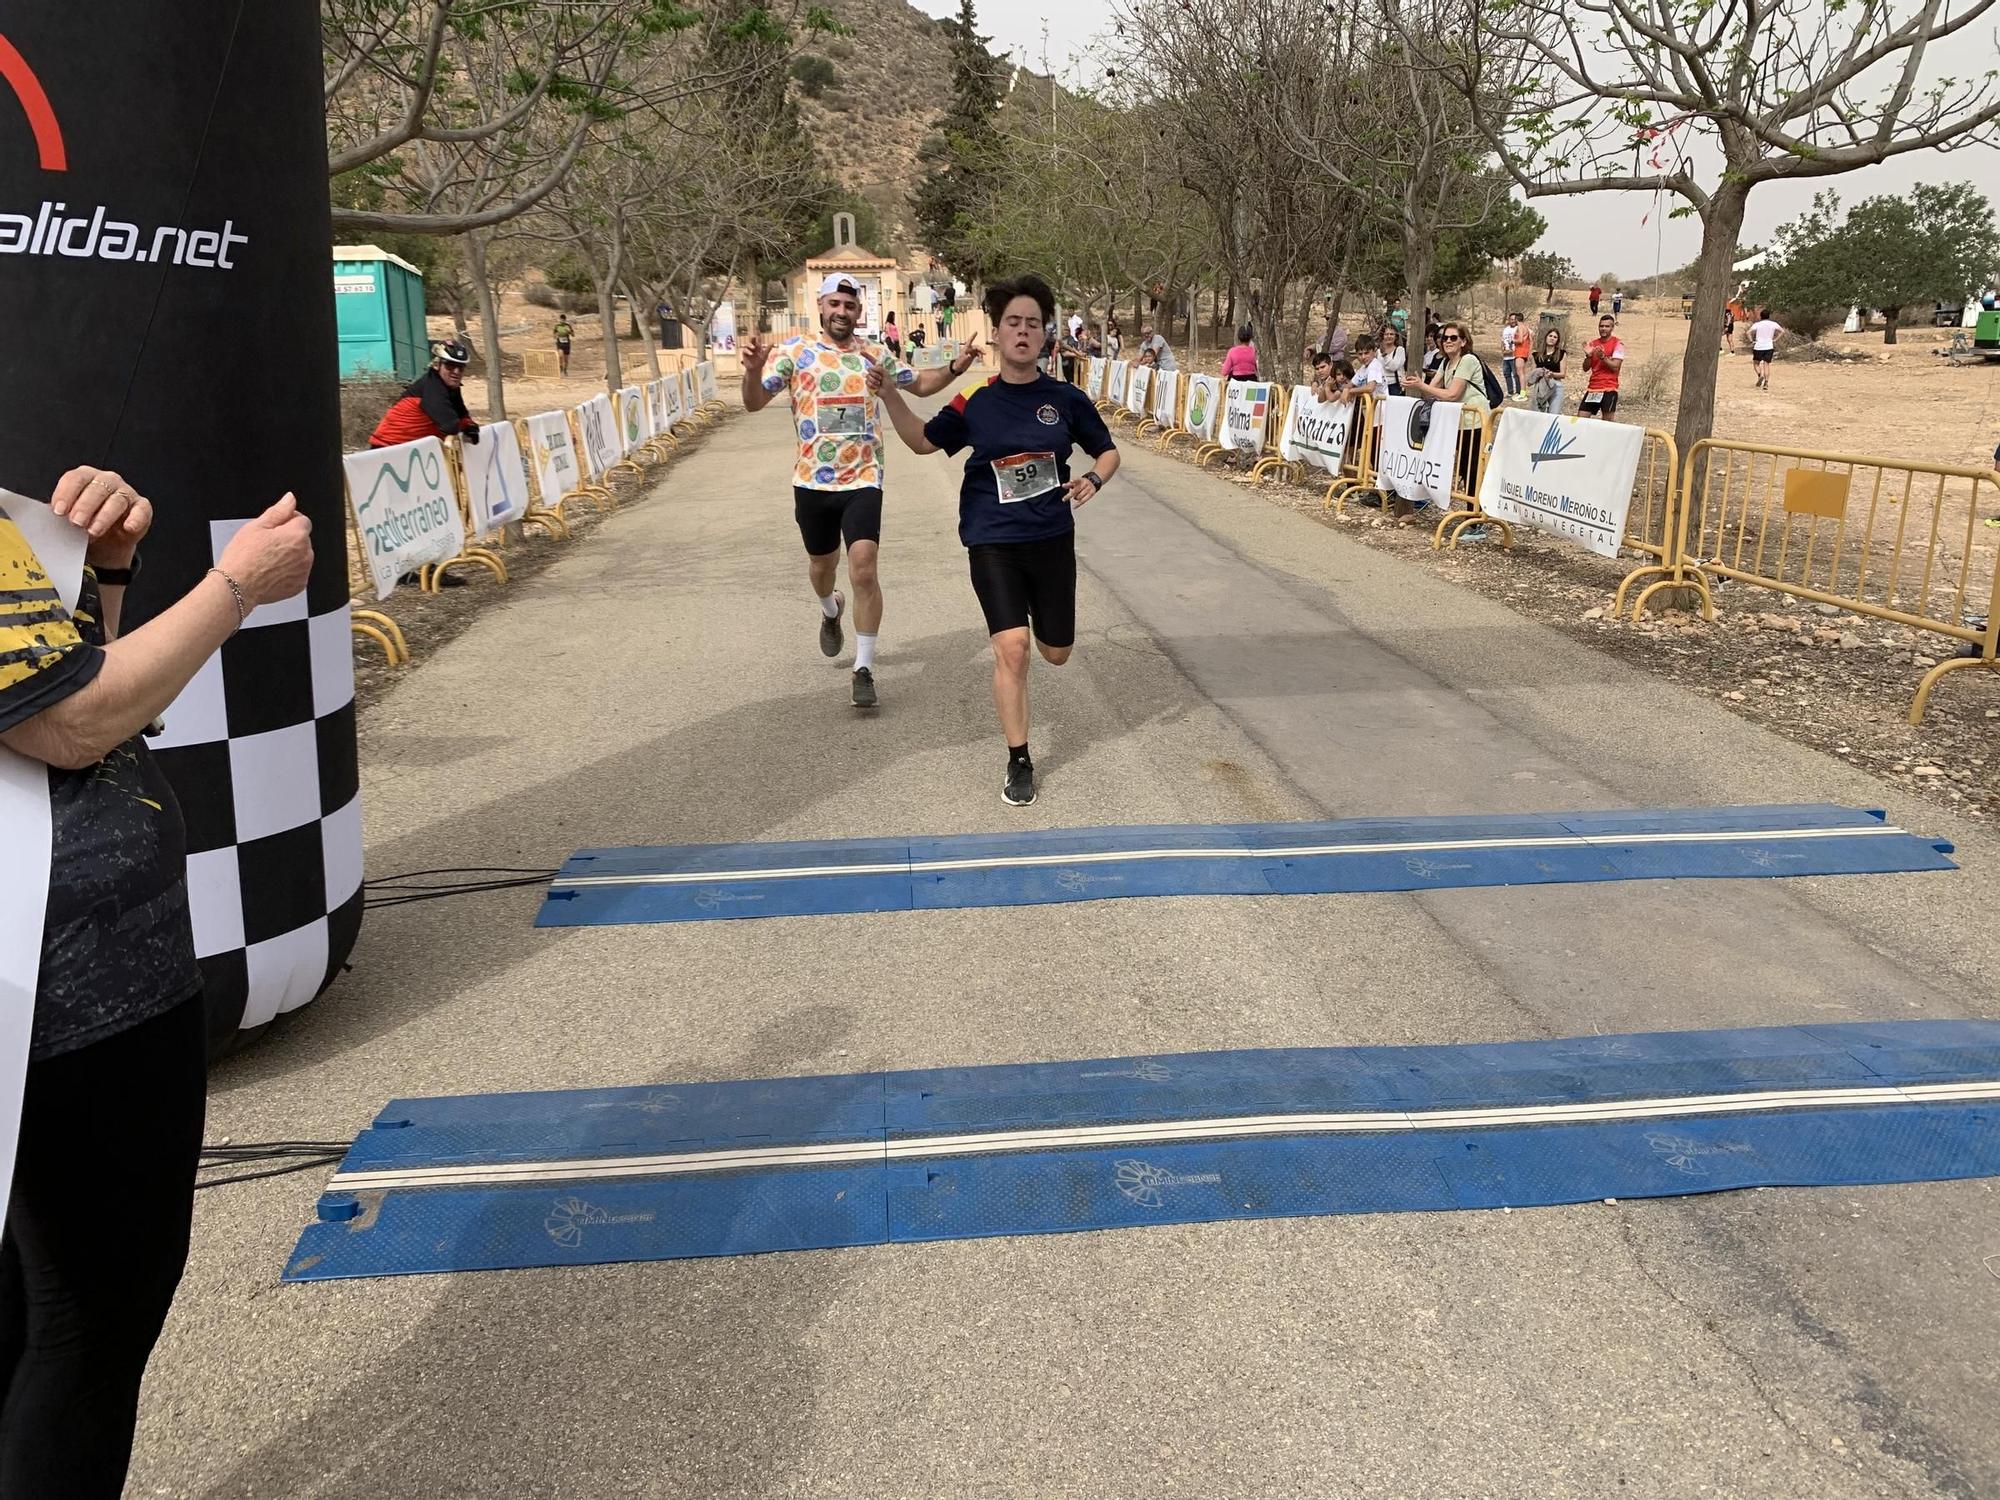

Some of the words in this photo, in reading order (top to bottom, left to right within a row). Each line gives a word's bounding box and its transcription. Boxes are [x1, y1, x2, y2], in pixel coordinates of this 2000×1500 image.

[837, 407, 847, 420] 7
[1014, 463, 1038, 483] 59
[1525, 485, 1559, 509] MORENO
[1560, 495, 1598, 520] MEROÑO
[1599, 510, 1617, 526] S.L.
[1497, 500, 1544, 523] SANIDAD
[1553, 518, 1614, 546] VEGETAL
